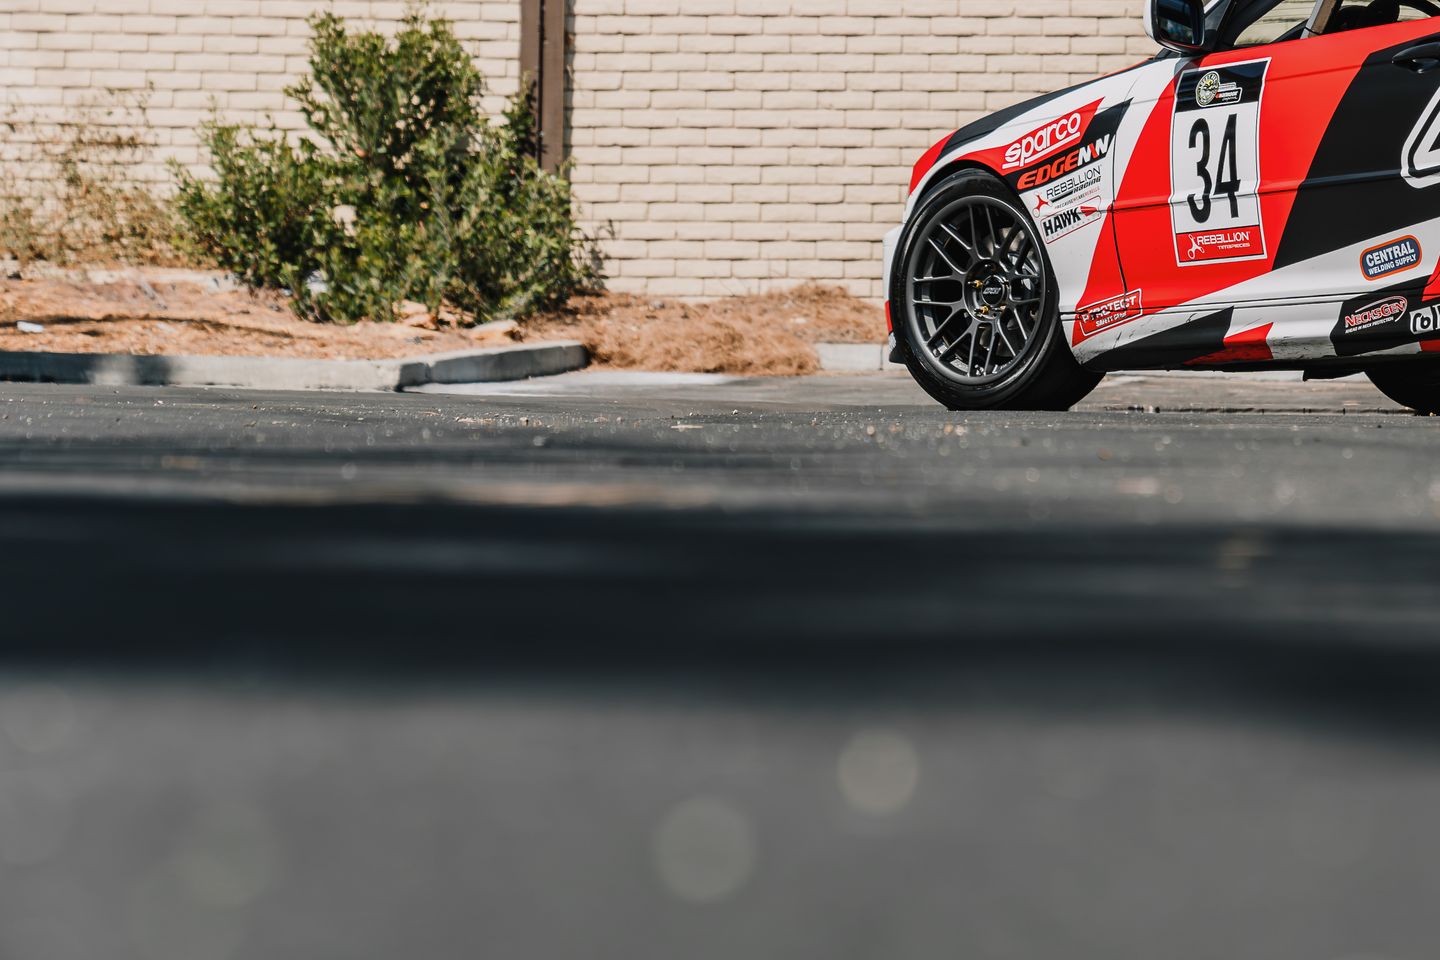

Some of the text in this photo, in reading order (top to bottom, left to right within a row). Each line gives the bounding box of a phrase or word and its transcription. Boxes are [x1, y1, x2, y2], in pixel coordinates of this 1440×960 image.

[1002, 112, 1081, 169] sparco
[1187, 113, 1241, 224] 34
[1042, 206, 1082, 237] HAWK
[1365, 241, 1415, 268] CENTRAL
[1367, 253, 1417, 276] WELDING SUPPLY
